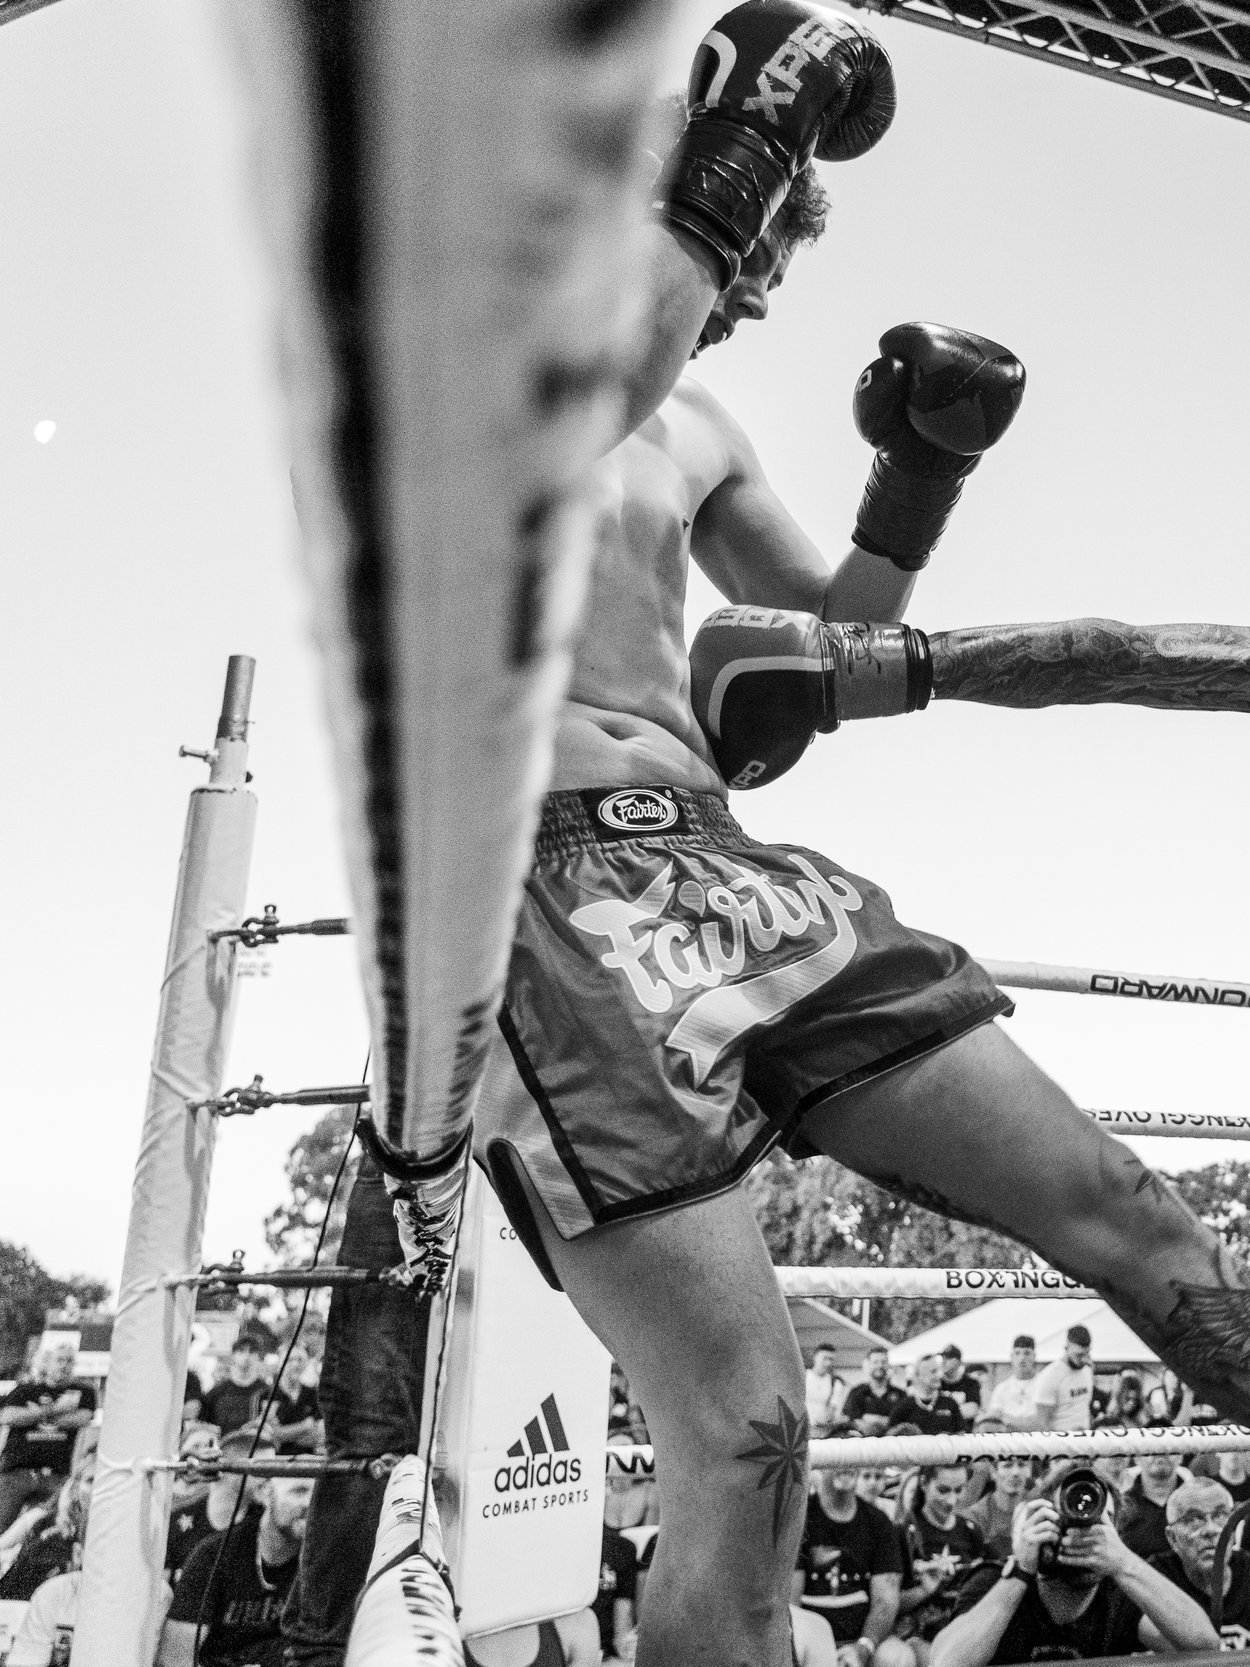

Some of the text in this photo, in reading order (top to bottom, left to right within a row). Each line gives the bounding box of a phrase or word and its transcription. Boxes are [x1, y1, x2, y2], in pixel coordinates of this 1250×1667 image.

[615, 795, 667, 823] Fairtex
[569, 856, 863, 1040] Fairtex
[494, 1454, 581, 1493] adidas
[482, 1489, 589, 1518] COMBAT SPORTS
